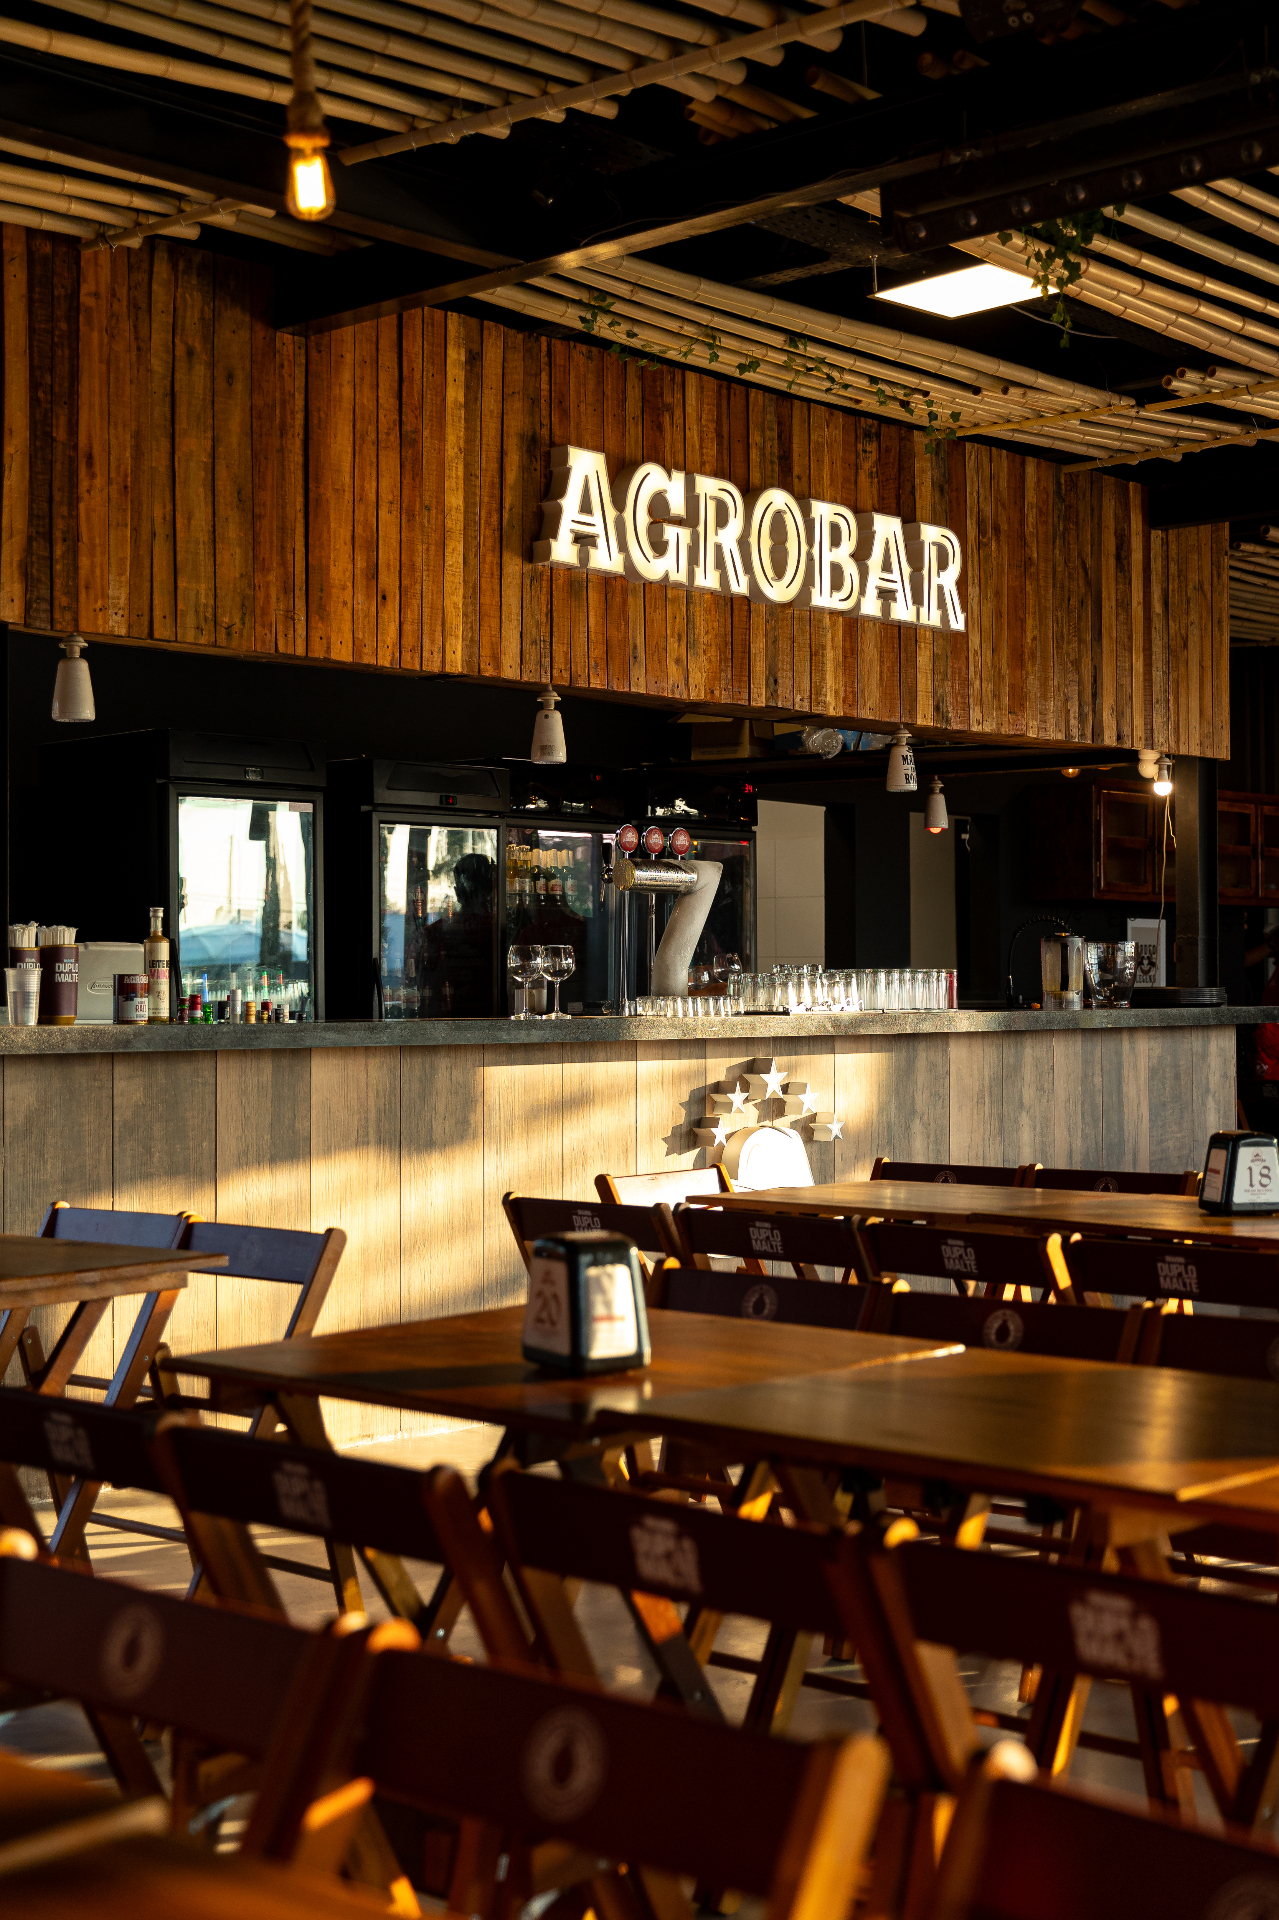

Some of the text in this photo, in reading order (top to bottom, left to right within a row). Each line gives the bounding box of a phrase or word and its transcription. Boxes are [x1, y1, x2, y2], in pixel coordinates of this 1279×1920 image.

[550, 445, 967, 632] AGROBAR
[55, 963, 79, 972] DUPLO
[55, 973, 79, 983] MALTE
[1246, 1165, 1272, 1188] 18
[572, 1215, 601, 1229] DUPLO
[749, 1227, 782, 1242] DUPLO
[752, 1240, 785, 1254] MALTE
[941, 1245, 976, 1260] DUPLO
[944, 1257, 979, 1273] MALTE
[1156, 1262, 1198, 1279] DUPLO
[1159, 1276, 1200, 1293] MALTE
